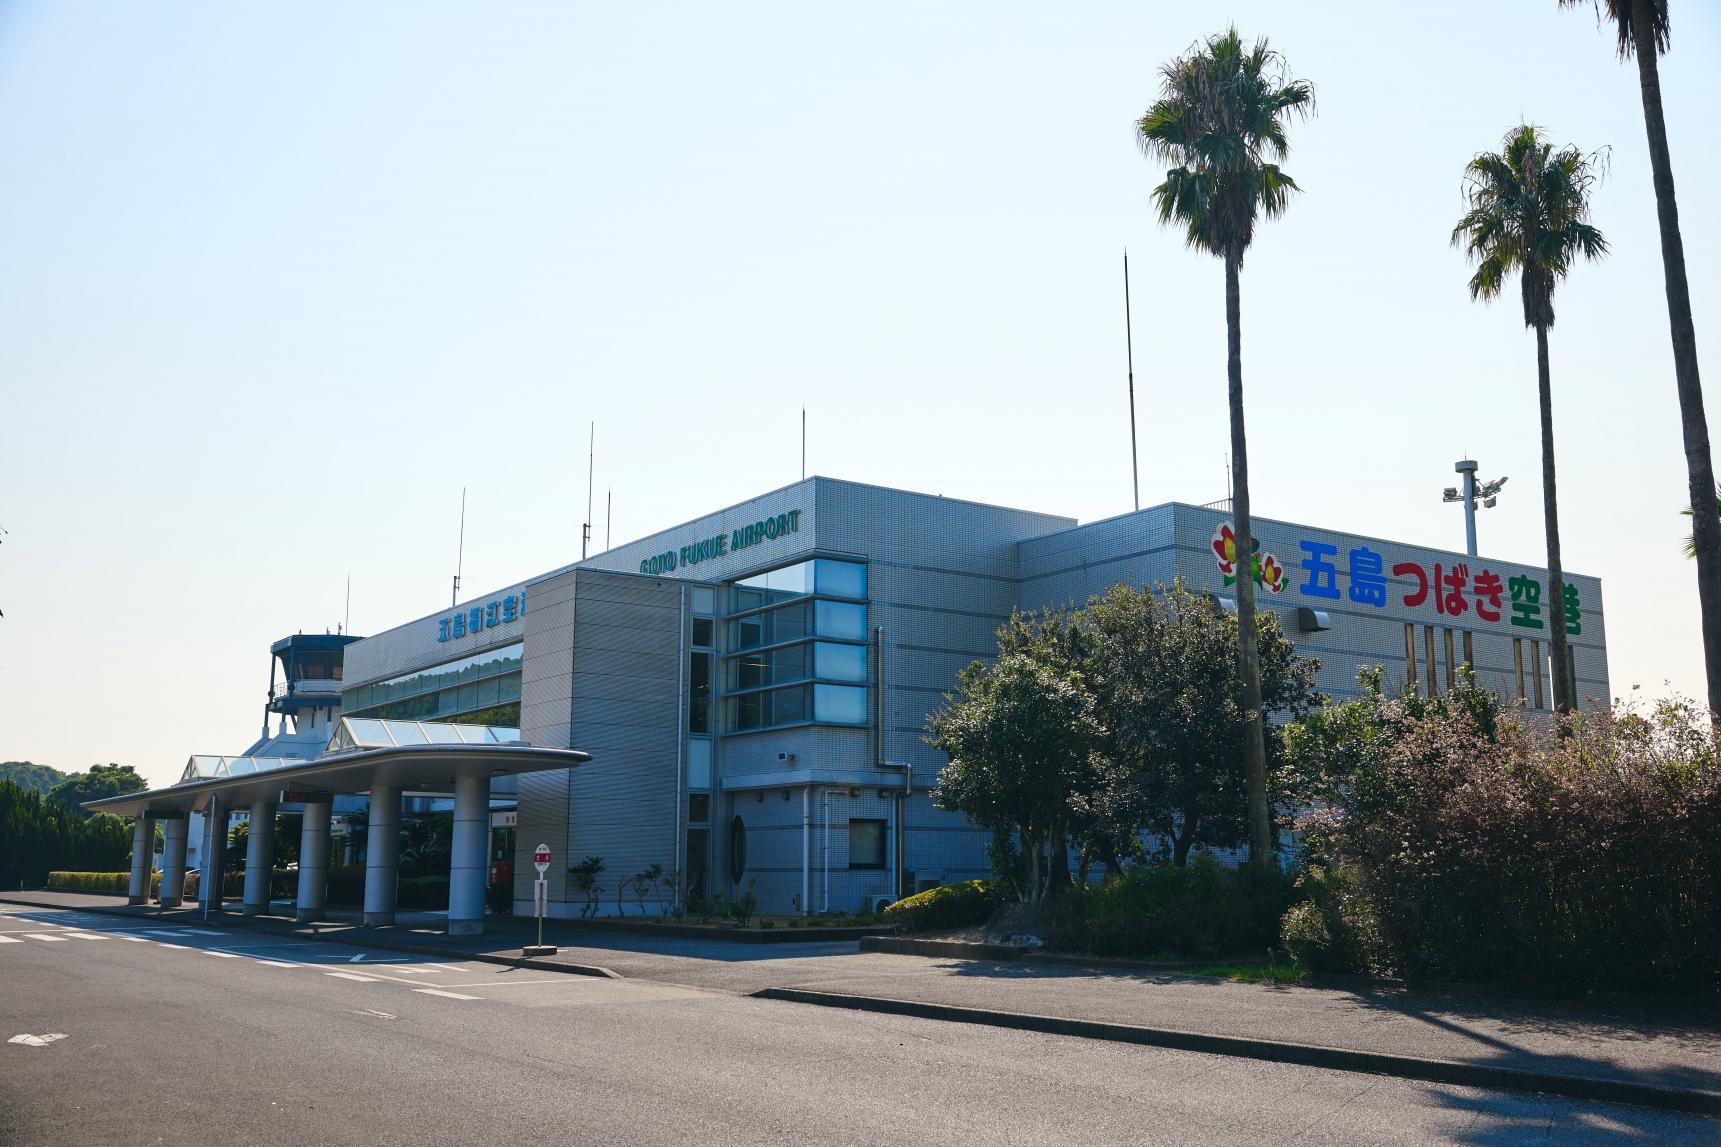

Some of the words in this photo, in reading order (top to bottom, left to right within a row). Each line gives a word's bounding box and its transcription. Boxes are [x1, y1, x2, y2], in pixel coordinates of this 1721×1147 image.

[640, 550, 676, 575] GOTO
[680, 534, 726, 567] FUKUE
[731, 509, 799, 551] AIRPORT
[438, 591, 526, 642] 五島福江空
